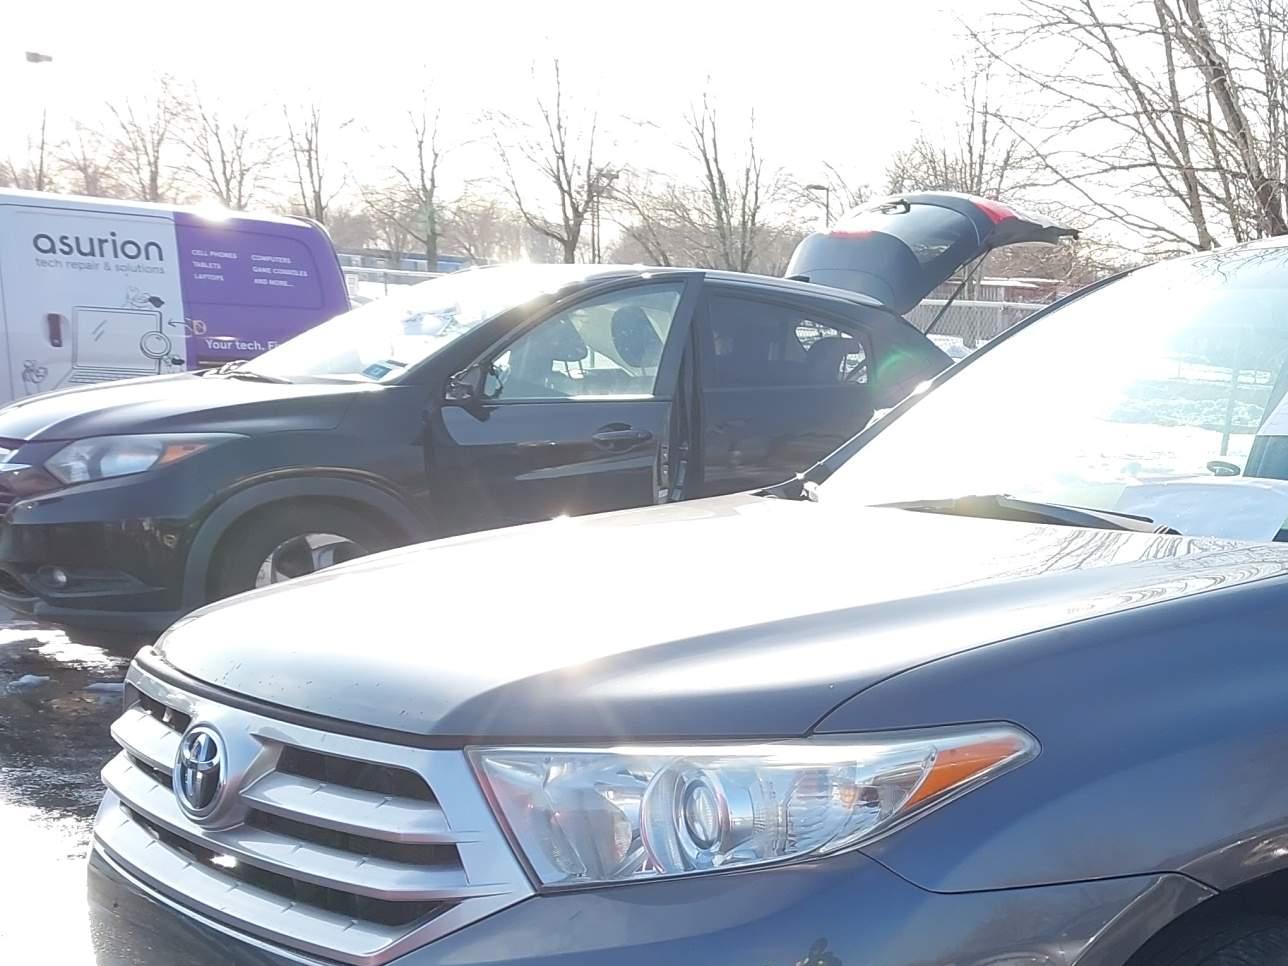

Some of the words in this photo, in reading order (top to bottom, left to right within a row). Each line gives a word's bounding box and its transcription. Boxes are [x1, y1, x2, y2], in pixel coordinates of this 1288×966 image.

[33, 231, 164, 261] asurion
[191, 249, 209, 257] CELL
[209, 251, 238, 259] PHONES
[250, 254, 292, 264] COMPUTERS
[35, 258, 62, 268] tech
[65, 261, 100, 271] repair
[103, 262, 111, 271] &
[115, 264, 165, 274] solutions
[205, 339, 232, 350] Your
[235, 341, 265, 351] tech.
